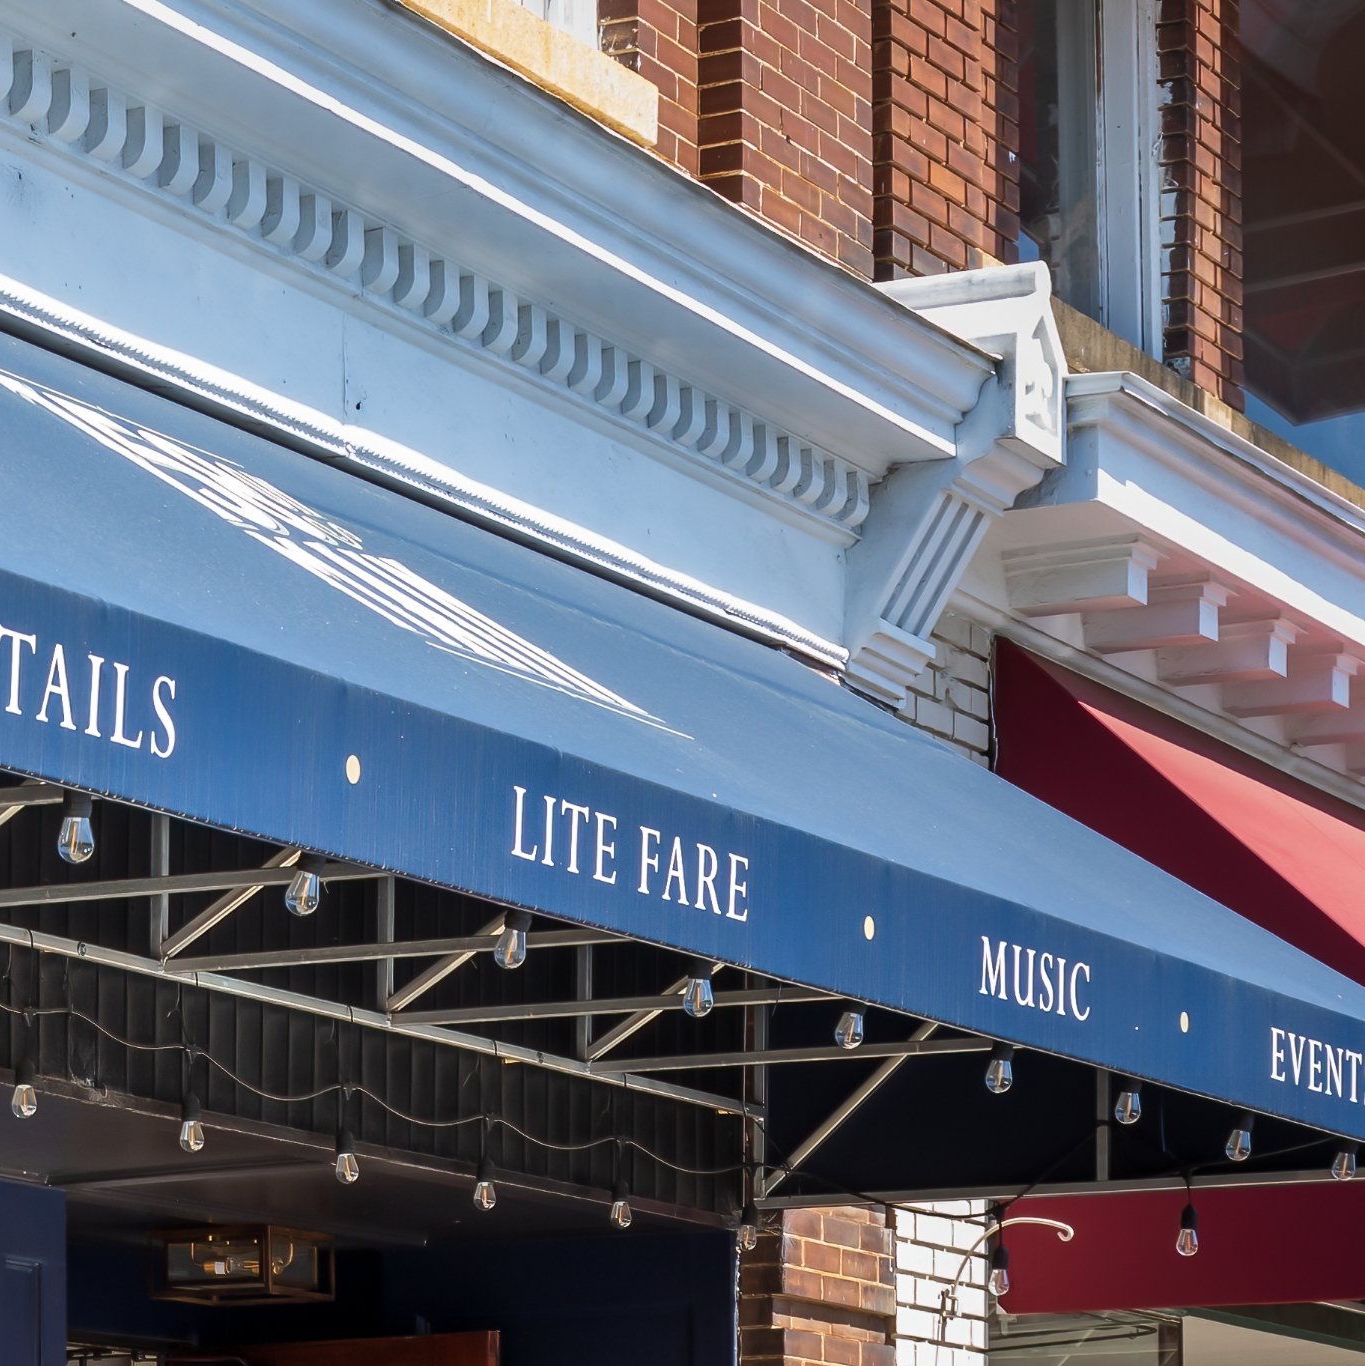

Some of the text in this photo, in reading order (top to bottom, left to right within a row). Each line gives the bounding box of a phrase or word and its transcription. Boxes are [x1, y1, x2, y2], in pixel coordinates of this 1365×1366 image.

[509, 786, 751, 925] LITE FARE
[979, 935, 1092, 1022] MUSIC
[1270, 1026, 1365, 1107] EVENT
